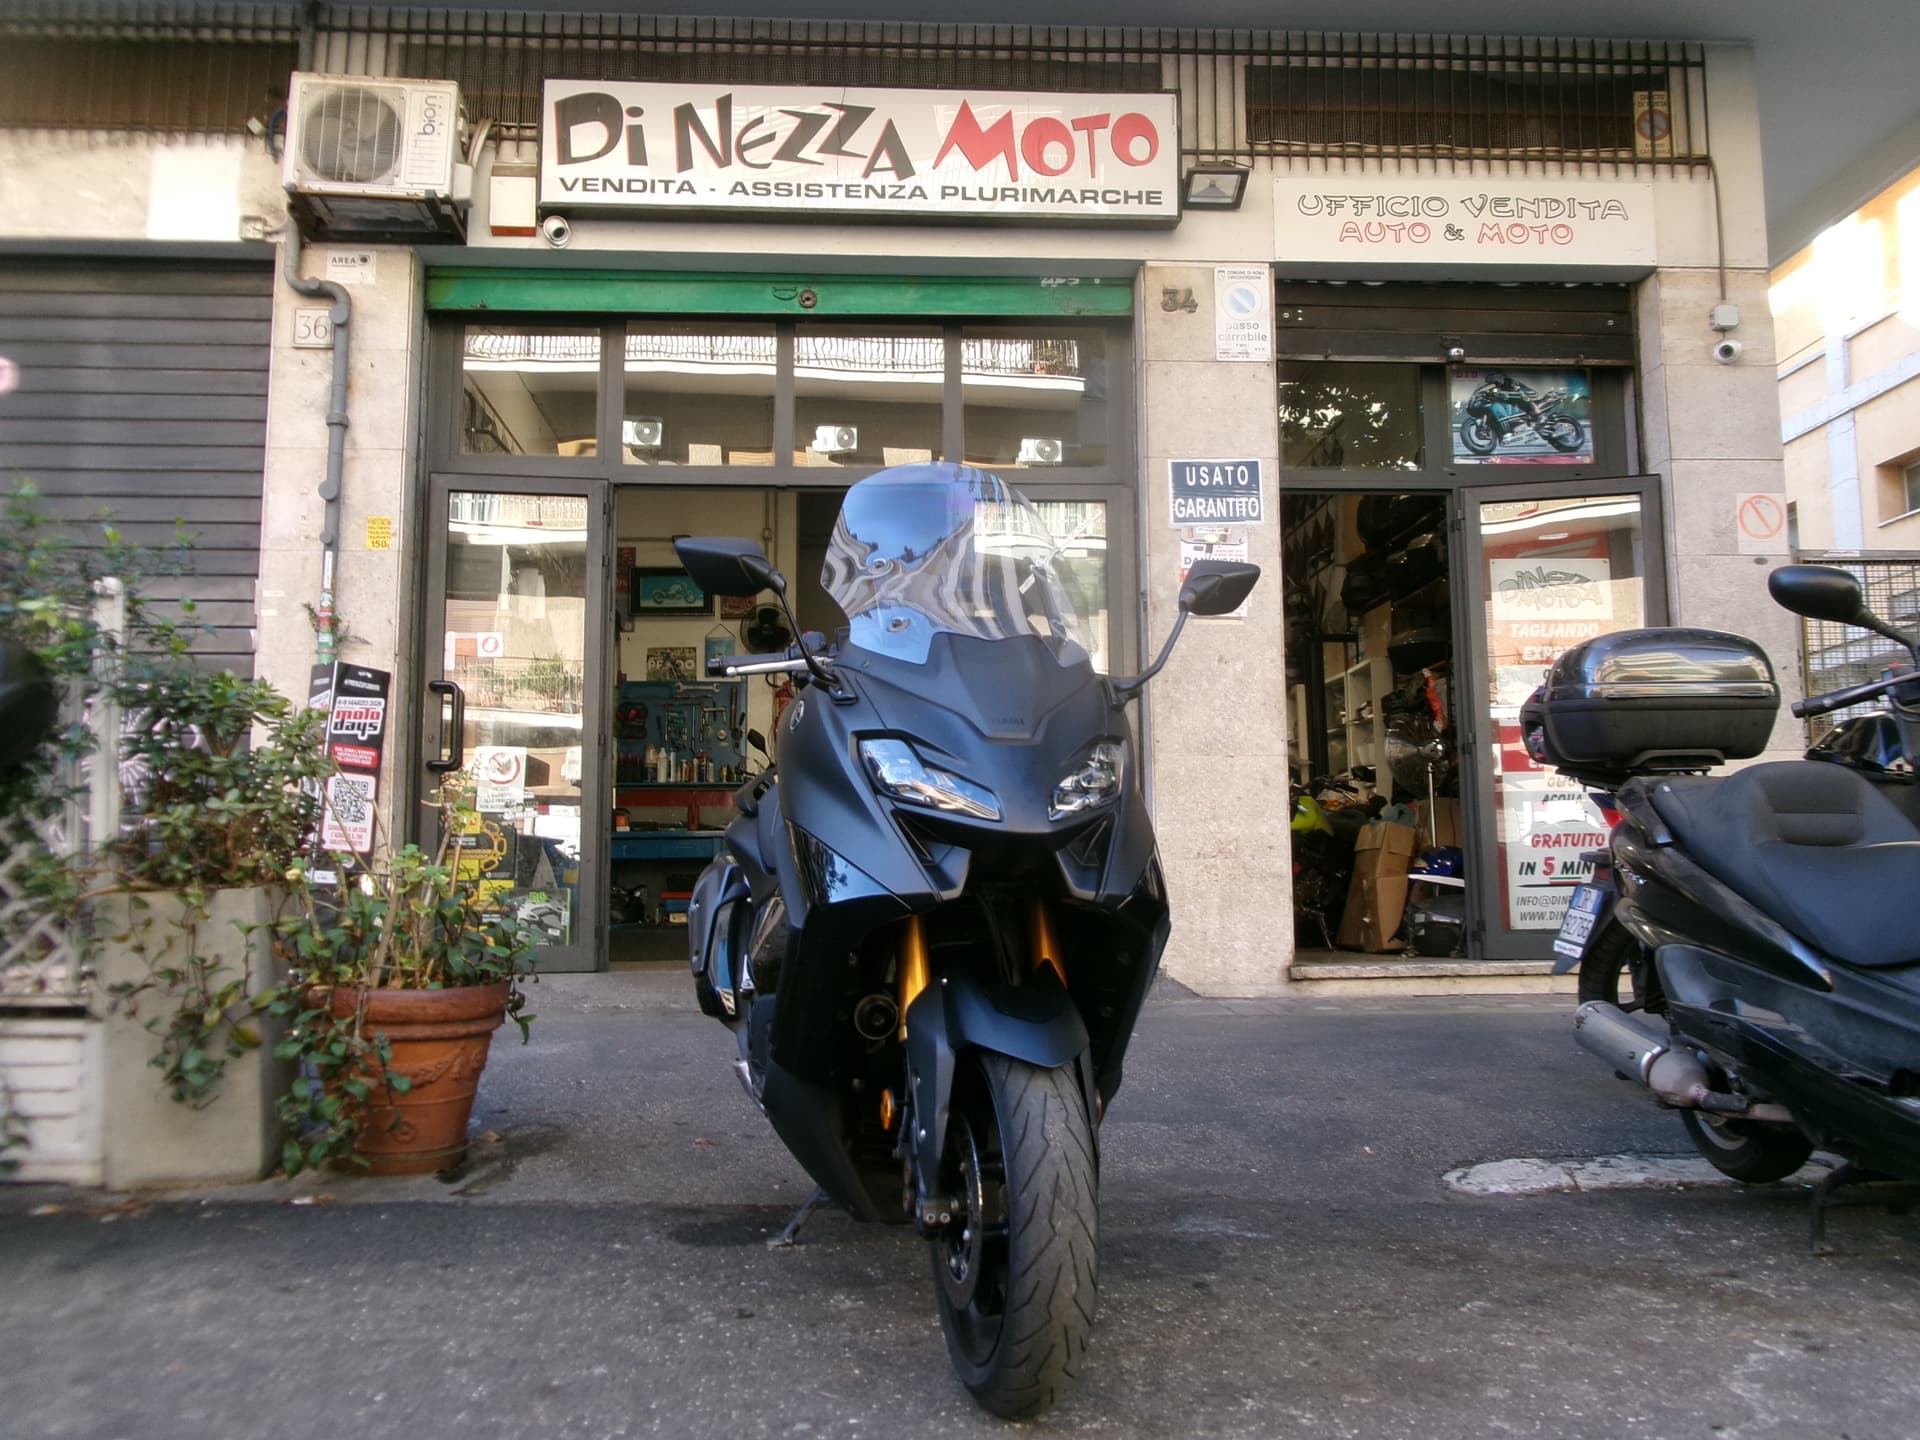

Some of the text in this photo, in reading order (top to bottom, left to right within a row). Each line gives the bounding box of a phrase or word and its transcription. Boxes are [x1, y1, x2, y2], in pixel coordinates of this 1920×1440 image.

[553, 92, 645, 166] Di
[932, 98, 1160, 183] MOTO
[558, 176, 697, 195] VENDITA
[728, 181, 928, 201] ASSISTENZA
[939, 185, 1163, 206] PLURIMARCHE
[1297, 193, 1629, 221] UFFICIO VENDITA
[1339, 221, 1574, 245] AUTO & MOTO
[331, 256, 356, 265] AREA
[297, 314, 329, 342] 36
[1218, 331, 1268, 342] carrabile
[1186, 466, 1249, 486] USATO
[1175, 497, 1260, 518] GARANTITO
[1510, 622, 1599, 638] TAGLIANDO
[335, 707, 381, 720] moto
[333, 718, 380, 738] days
[1531, 832, 1605, 848] GRATUITO
[1517, 861, 1536, 877] IN
[1542, 857, 1555, 877] 5
[1560, 859, 1594, 876] MIN
